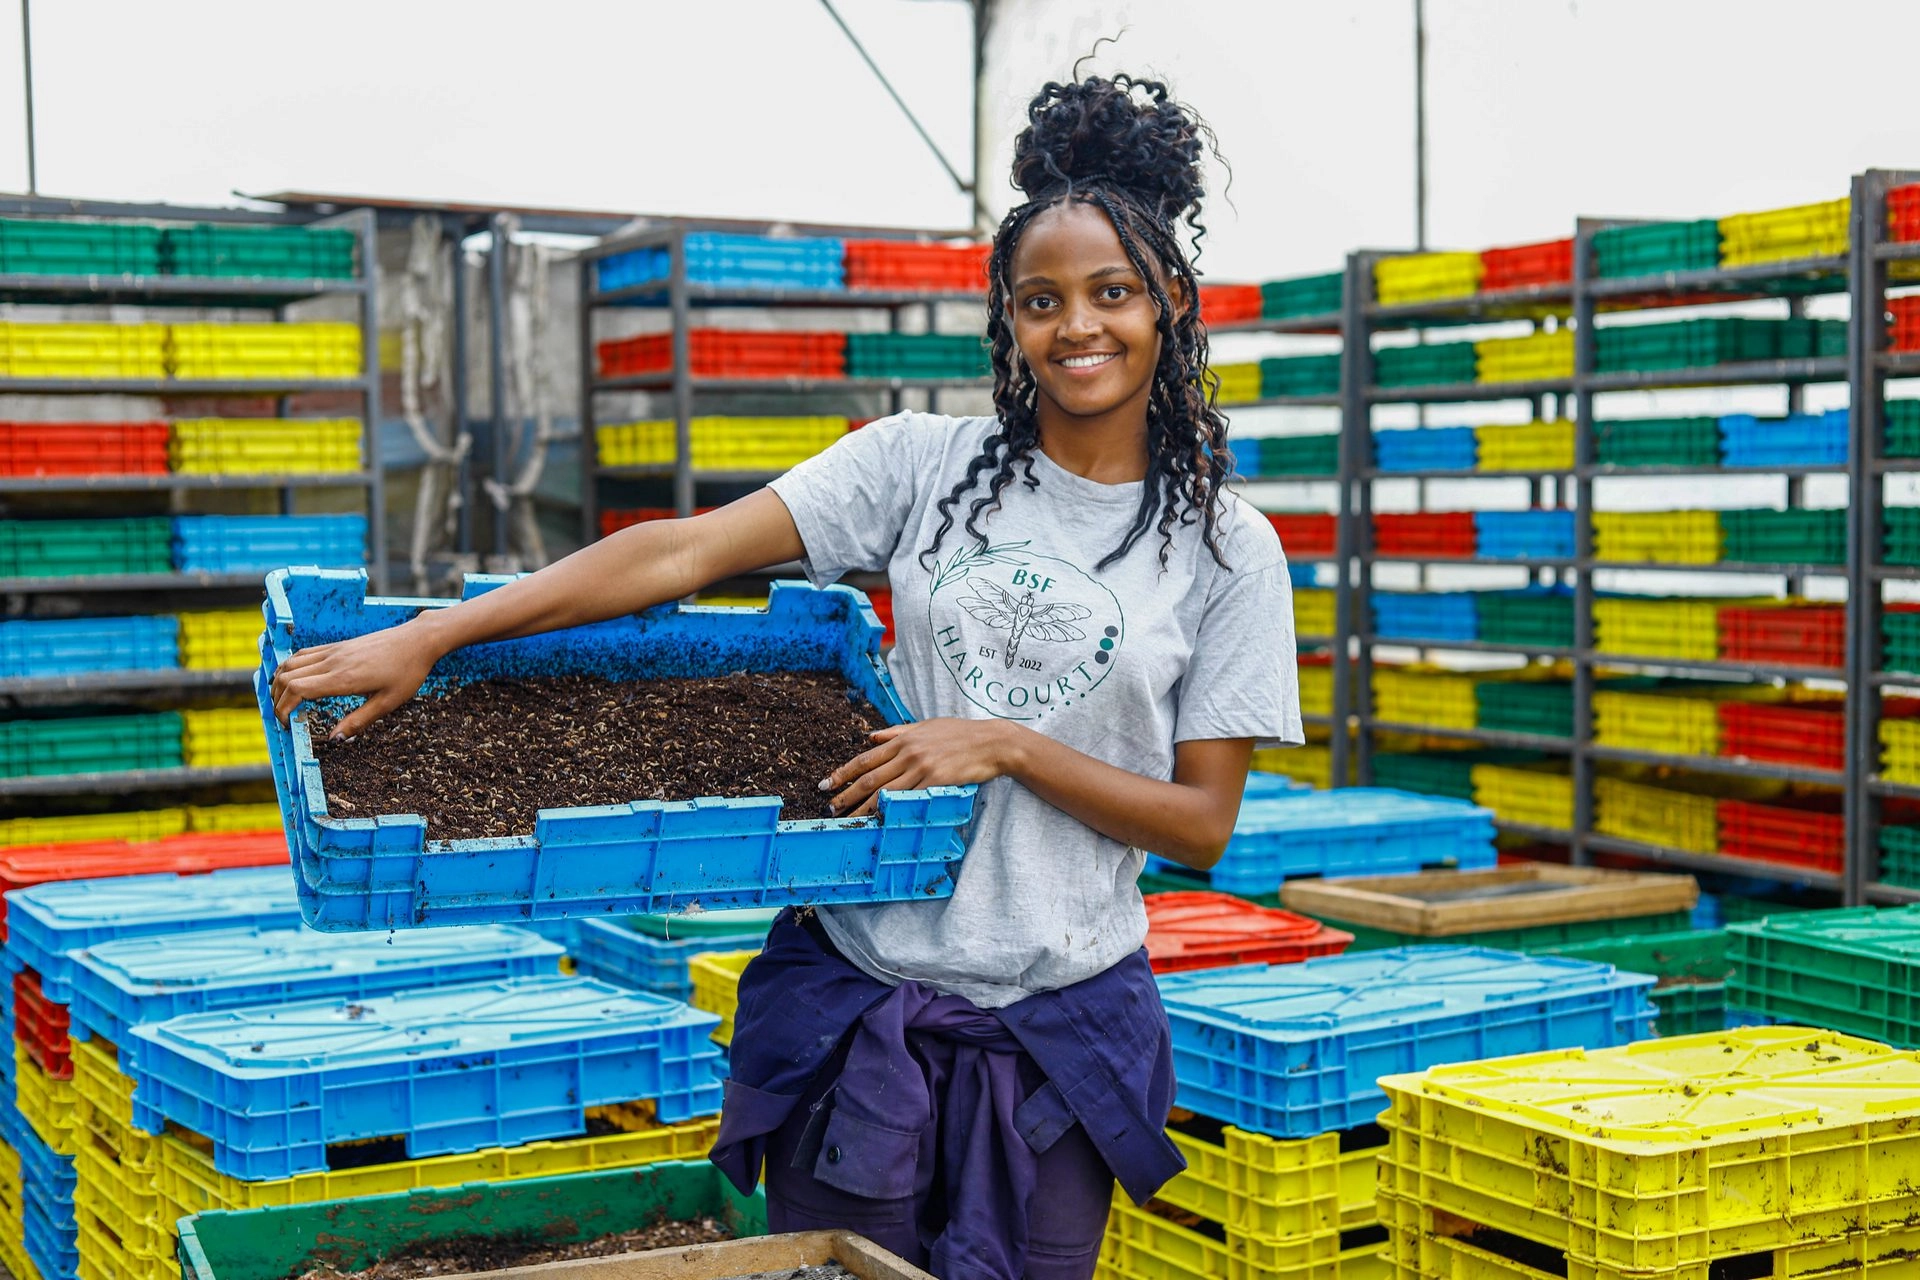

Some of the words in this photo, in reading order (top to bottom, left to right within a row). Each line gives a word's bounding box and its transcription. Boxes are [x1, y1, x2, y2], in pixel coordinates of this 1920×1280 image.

[1012, 569, 1056, 592] BSF
[938, 626, 1092, 707] HARCOURT
[979, 646, 997, 659] EST
[1019, 658, 1042, 671] 2022
